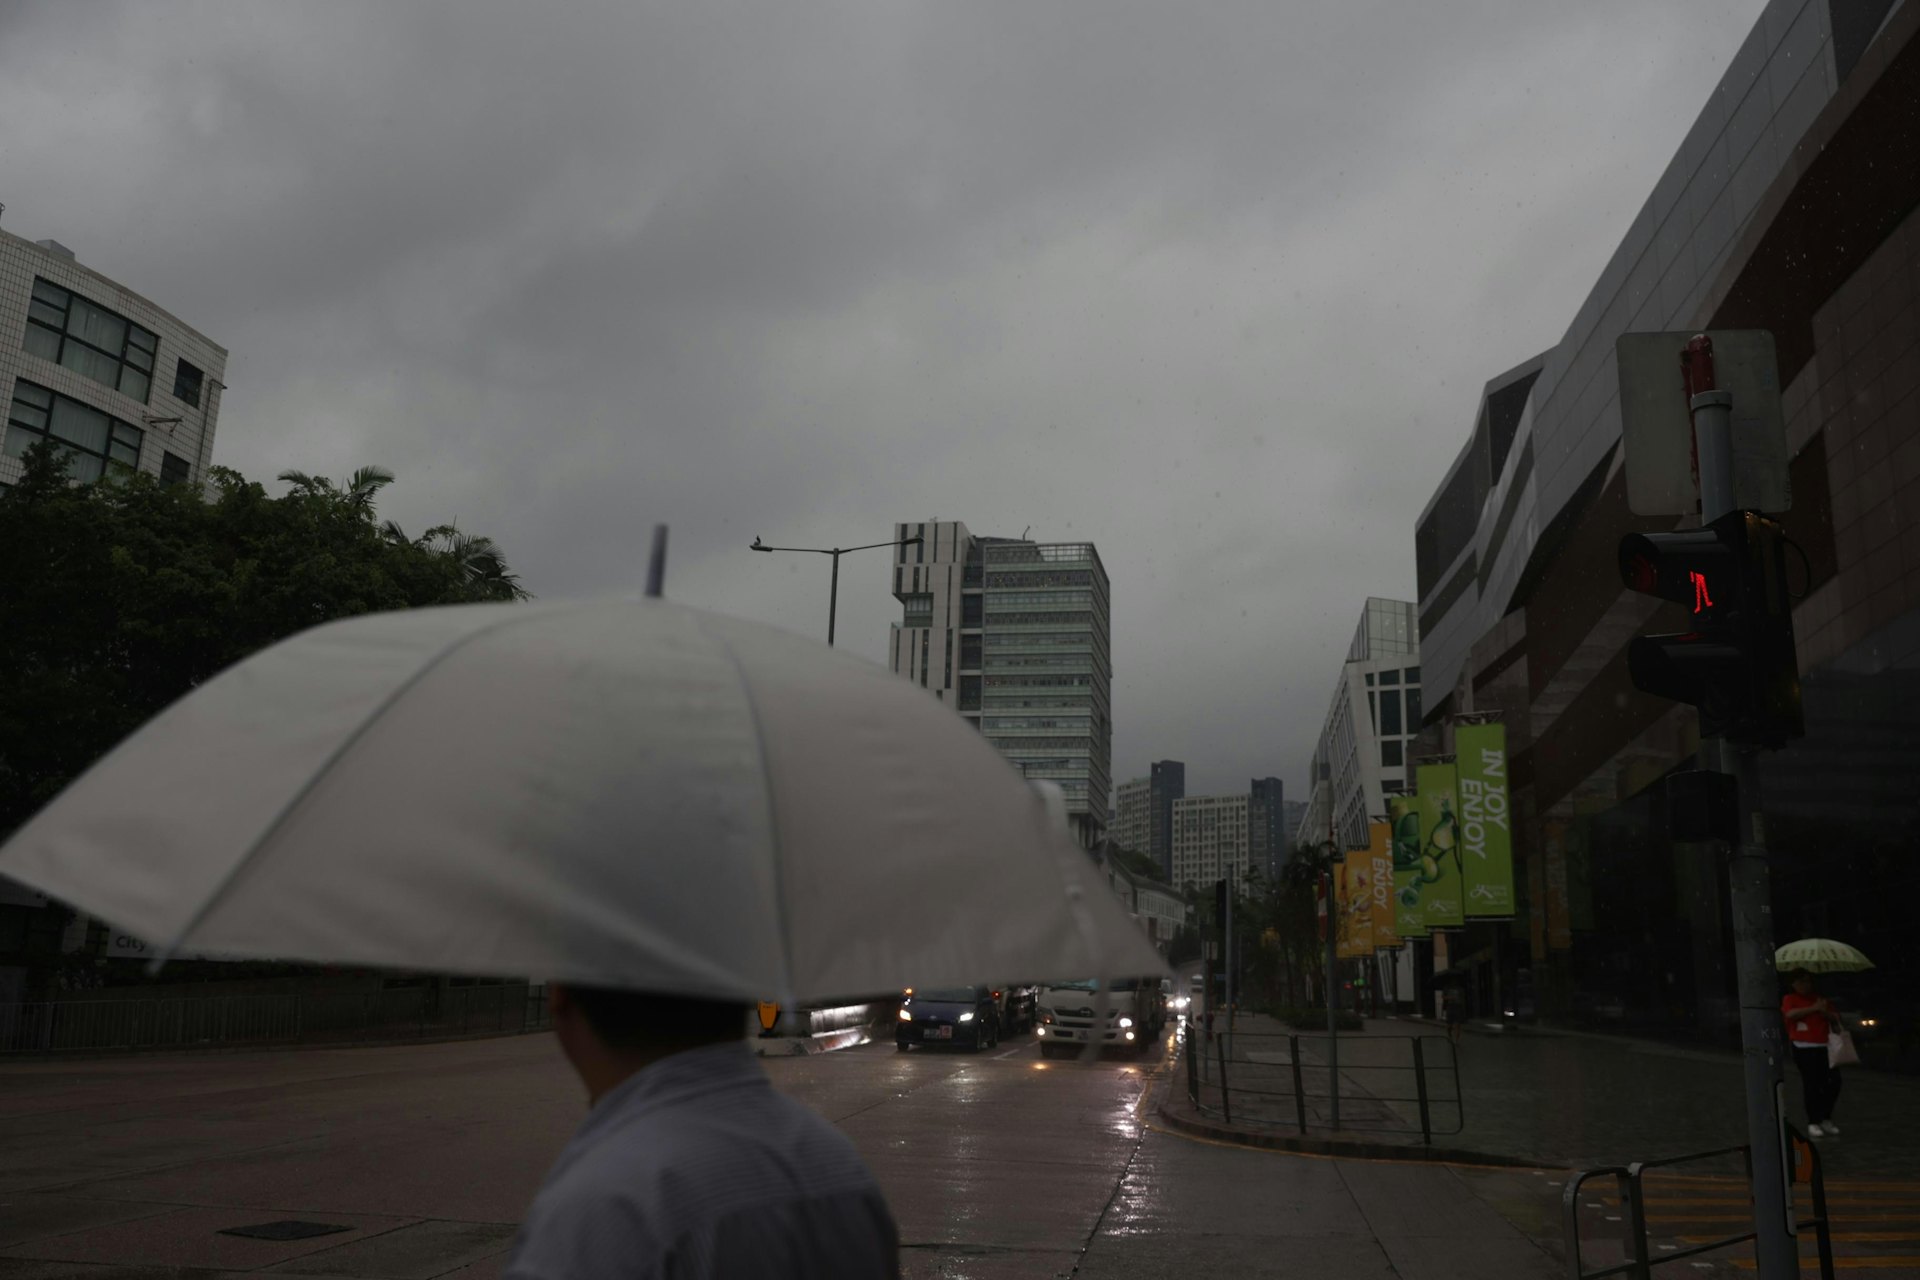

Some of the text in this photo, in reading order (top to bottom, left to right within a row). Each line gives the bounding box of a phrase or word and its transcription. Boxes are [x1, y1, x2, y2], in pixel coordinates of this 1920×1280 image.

[1461, 777, 1487, 859] ENJOY
[1481, 748, 1507, 831] IN JOY
[1371, 857, 1388, 910] ENJOY
[115, 935, 147, 953] City
